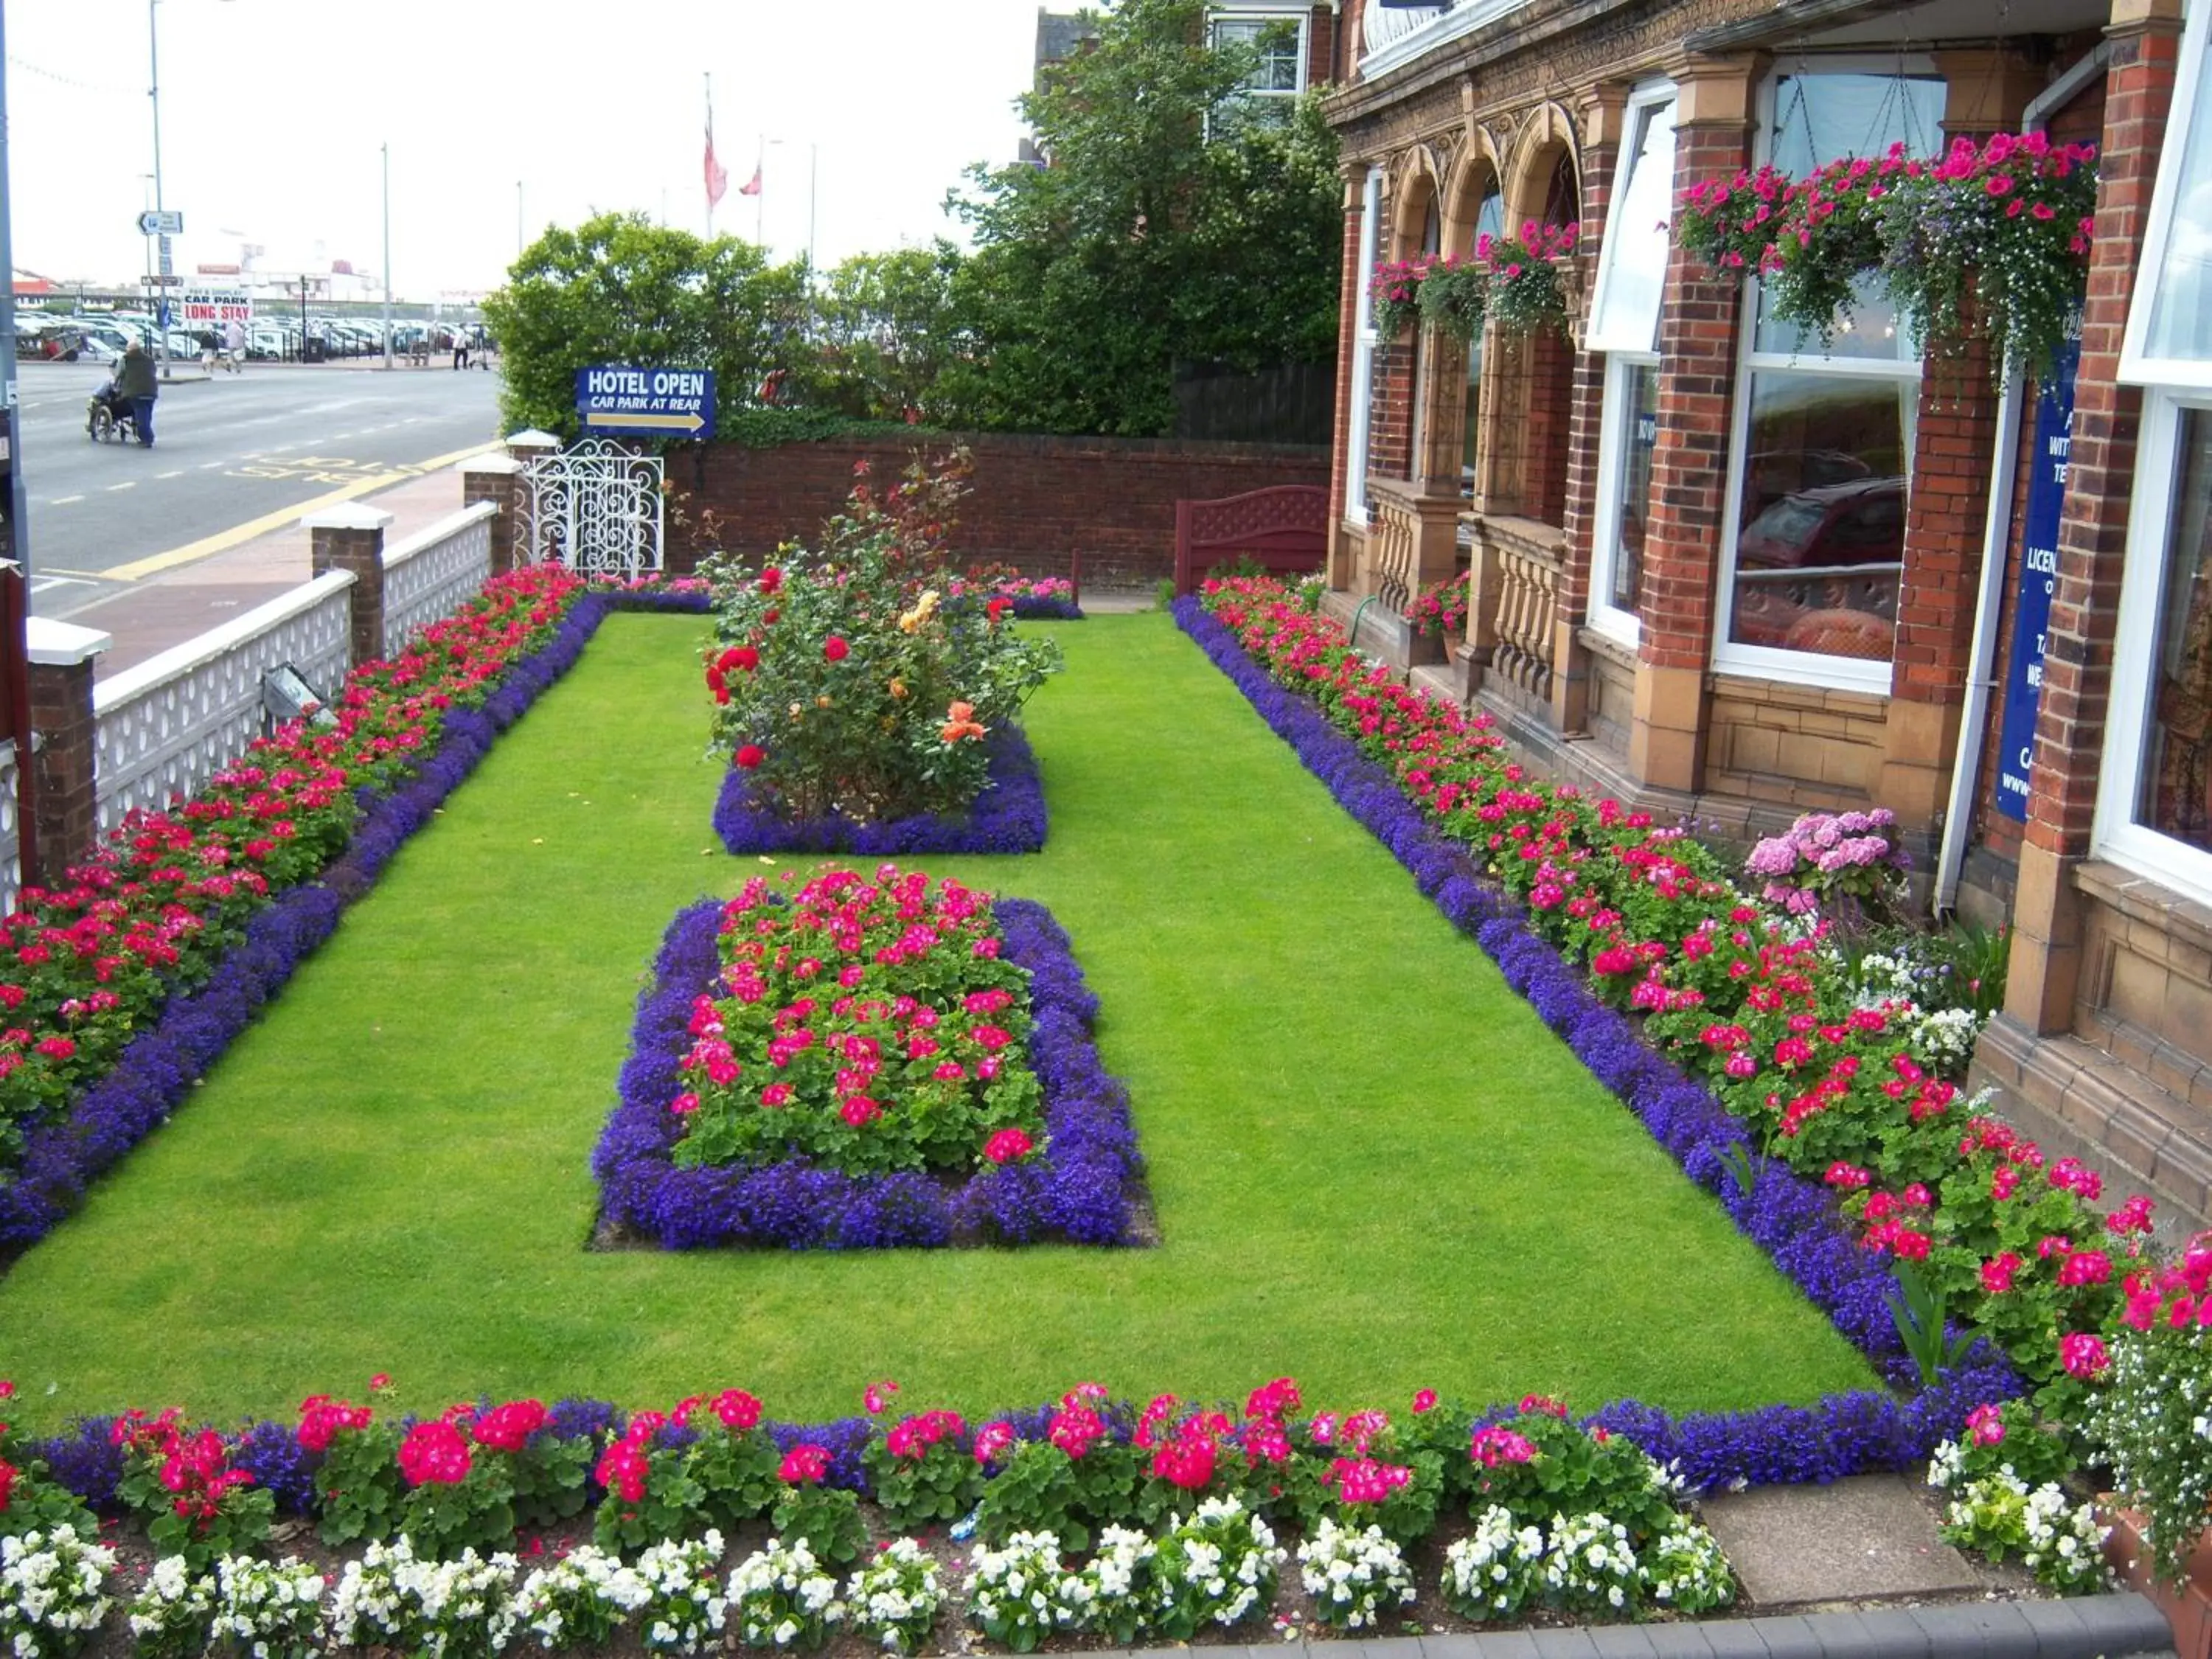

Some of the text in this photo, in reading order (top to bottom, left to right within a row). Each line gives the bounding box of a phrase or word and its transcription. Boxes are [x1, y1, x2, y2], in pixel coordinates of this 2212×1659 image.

[184, 295, 248, 305] CAR PARK
[185, 305, 250, 320] LONG STAY
[588, 371, 704, 396] HOTEL OPEN
[591, 396, 701, 411] CAR PARK AT REAR
